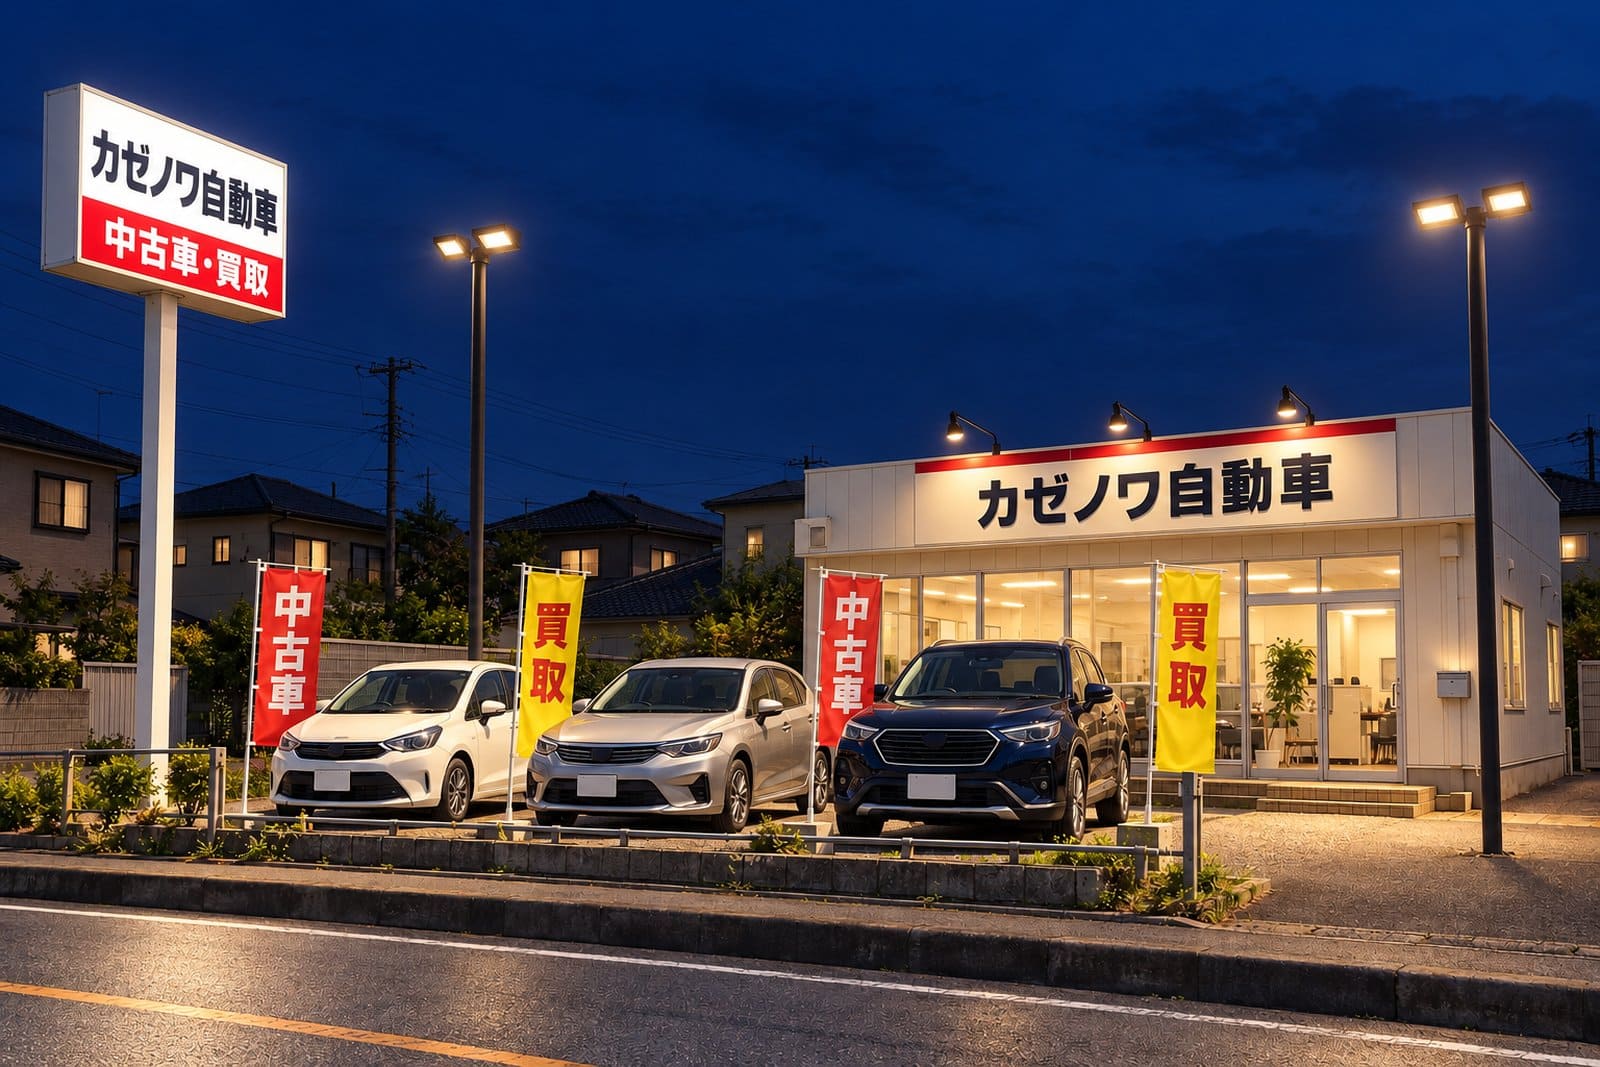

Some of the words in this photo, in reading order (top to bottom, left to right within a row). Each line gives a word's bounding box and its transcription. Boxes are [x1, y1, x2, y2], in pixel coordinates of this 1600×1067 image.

[91, 129, 278, 236] カゼノワ自動車
[104, 217, 269, 299] 中古車・買取
[978, 452, 1334, 529] カゼノワ自動車
[268, 585, 312, 716] 中古車
[530, 602, 571, 705] 買取
[830, 591, 869, 715] 中古車
[1168, 602, 1209, 710] 買取
